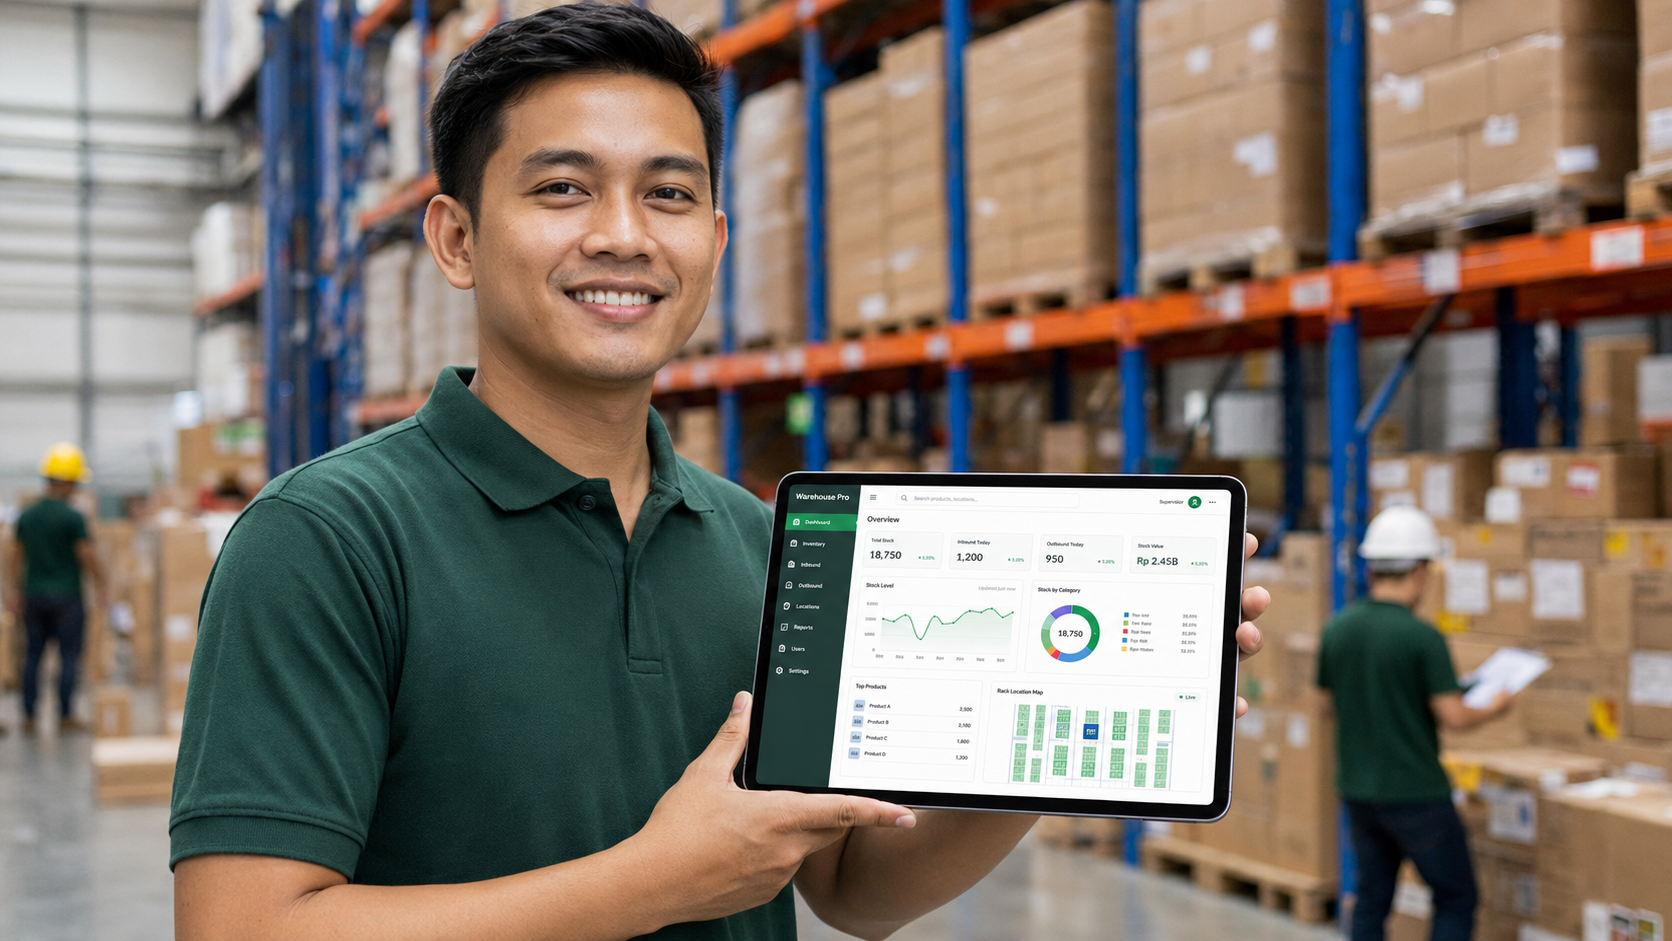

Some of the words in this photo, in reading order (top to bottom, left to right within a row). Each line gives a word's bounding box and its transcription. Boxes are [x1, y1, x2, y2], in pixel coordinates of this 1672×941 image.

[870, 551, 902, 560] 18,750
[957, 553, 983, 562] 1,200
[1046, 555, 1064, 563] 950
[1137, 557, 1149, 567] Rp
[1151, 557, 1178, 566] 2.45B
[1058, 630, 1083, 638] 18,750
